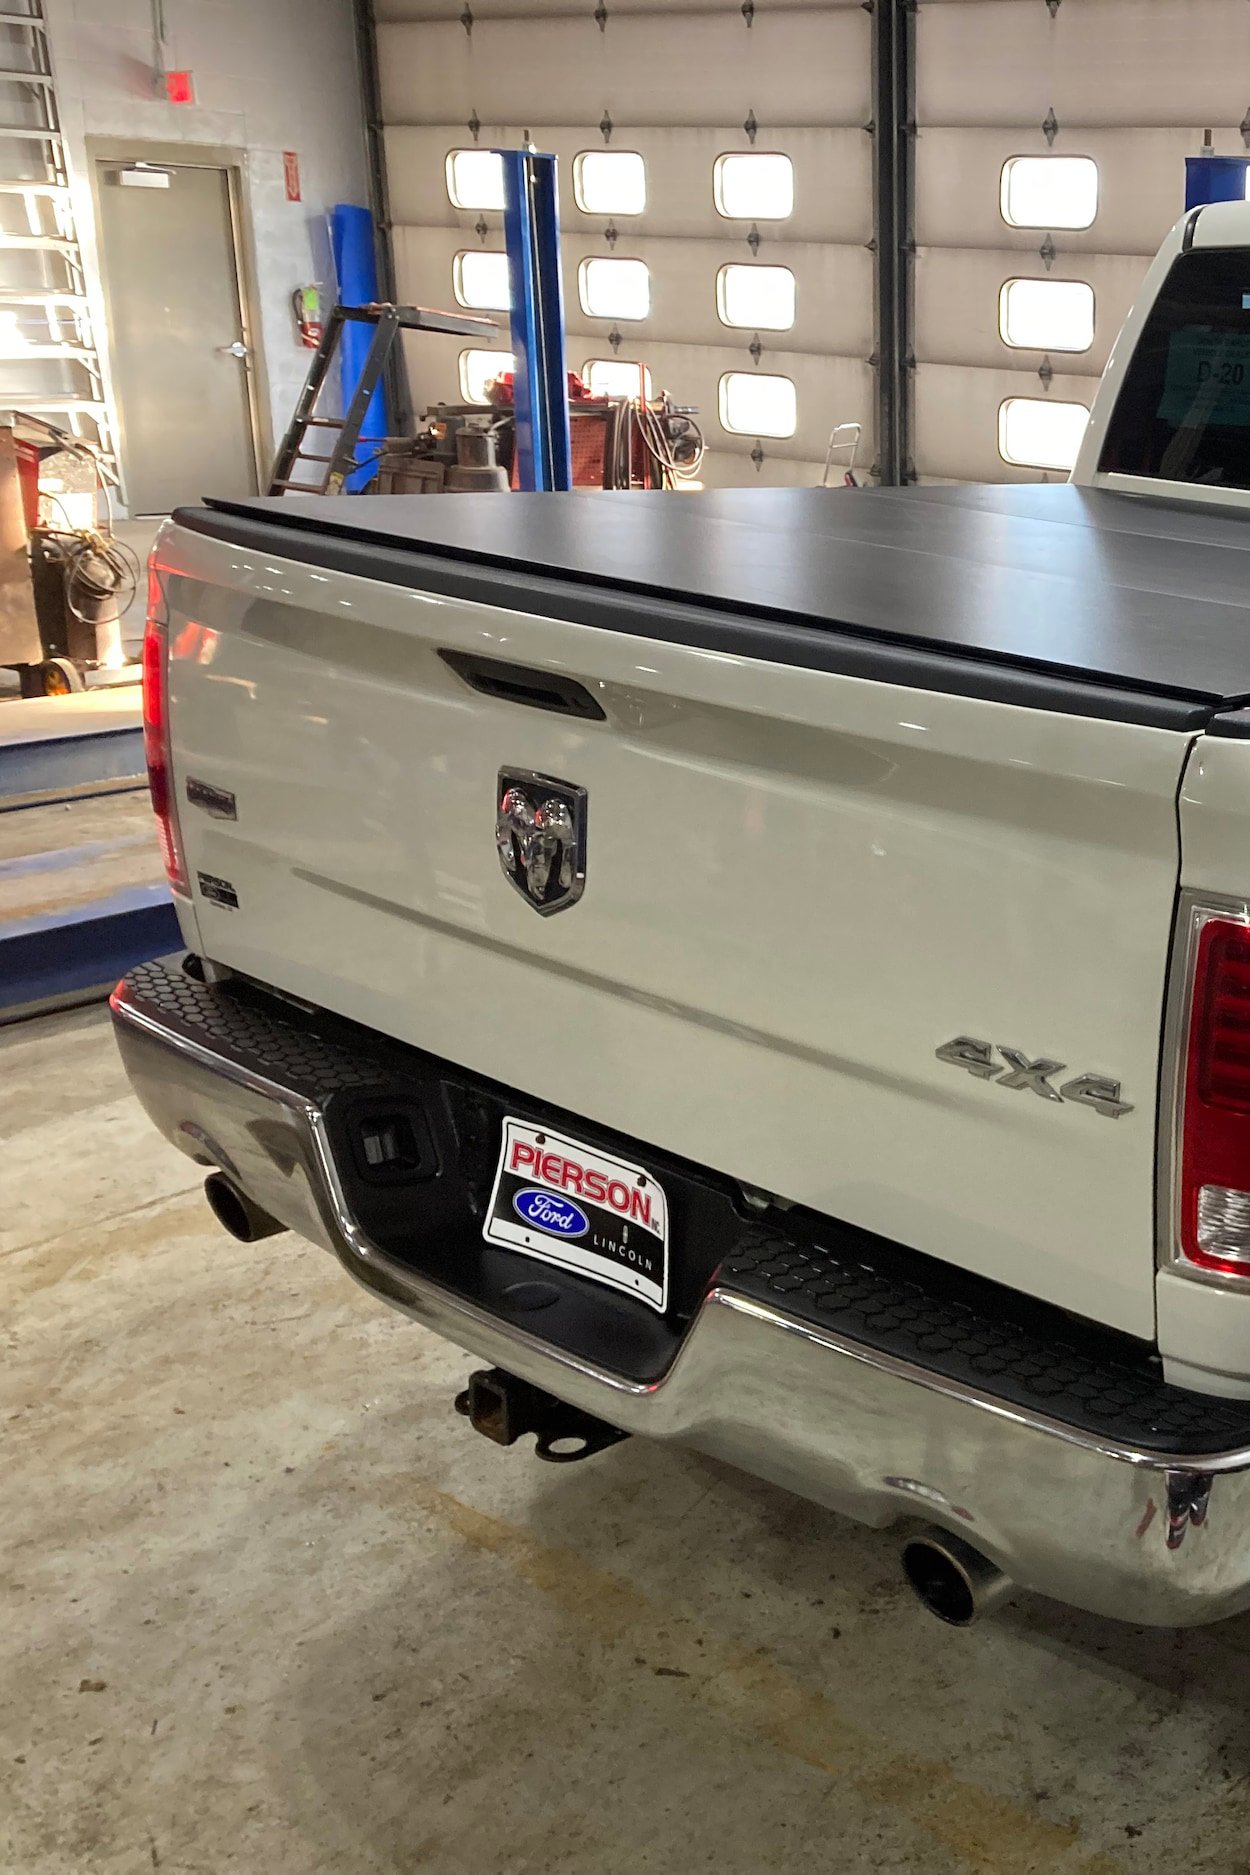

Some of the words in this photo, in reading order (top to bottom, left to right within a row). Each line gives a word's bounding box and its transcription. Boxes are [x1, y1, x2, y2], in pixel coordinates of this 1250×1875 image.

[510, 1139, 652, 1228] PIERSON
[527, 1194, 575, 1230] Ford
[593, 1233, 653, 1271] LINCOLN
